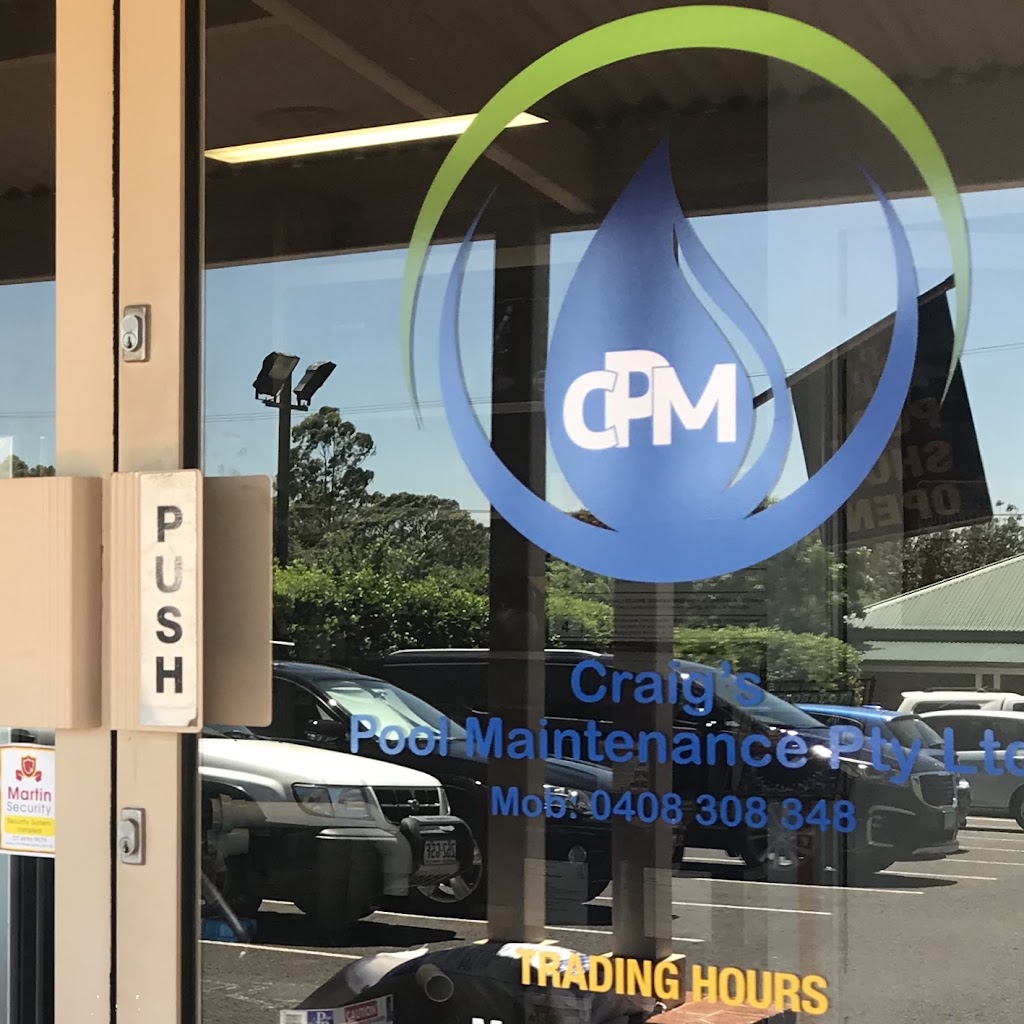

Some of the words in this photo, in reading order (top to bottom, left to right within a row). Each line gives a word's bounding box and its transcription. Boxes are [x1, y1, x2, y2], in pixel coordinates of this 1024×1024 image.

[563, 349, 736, 450] CPM
[155, 505, 184, 694] PUSH
[570, 659, 764, 717] Craig's
[349, 714, 448, 757] Pool
[465, 716, 808, 769] Maintenance
[829, 725, 922, 785] Pty
[6, 801, 52, 816] Security
[7, 786, 52, 802] Martin
[491, 786, 577, 819] Mob:
[590, 789, 682, 824] 0408
[696, 794, 767, 829] 308
[781, 798, 858, 833] 348
[515, 948, 679, 1000] TRADING
[692, 965, 829, 1015] HOURS
